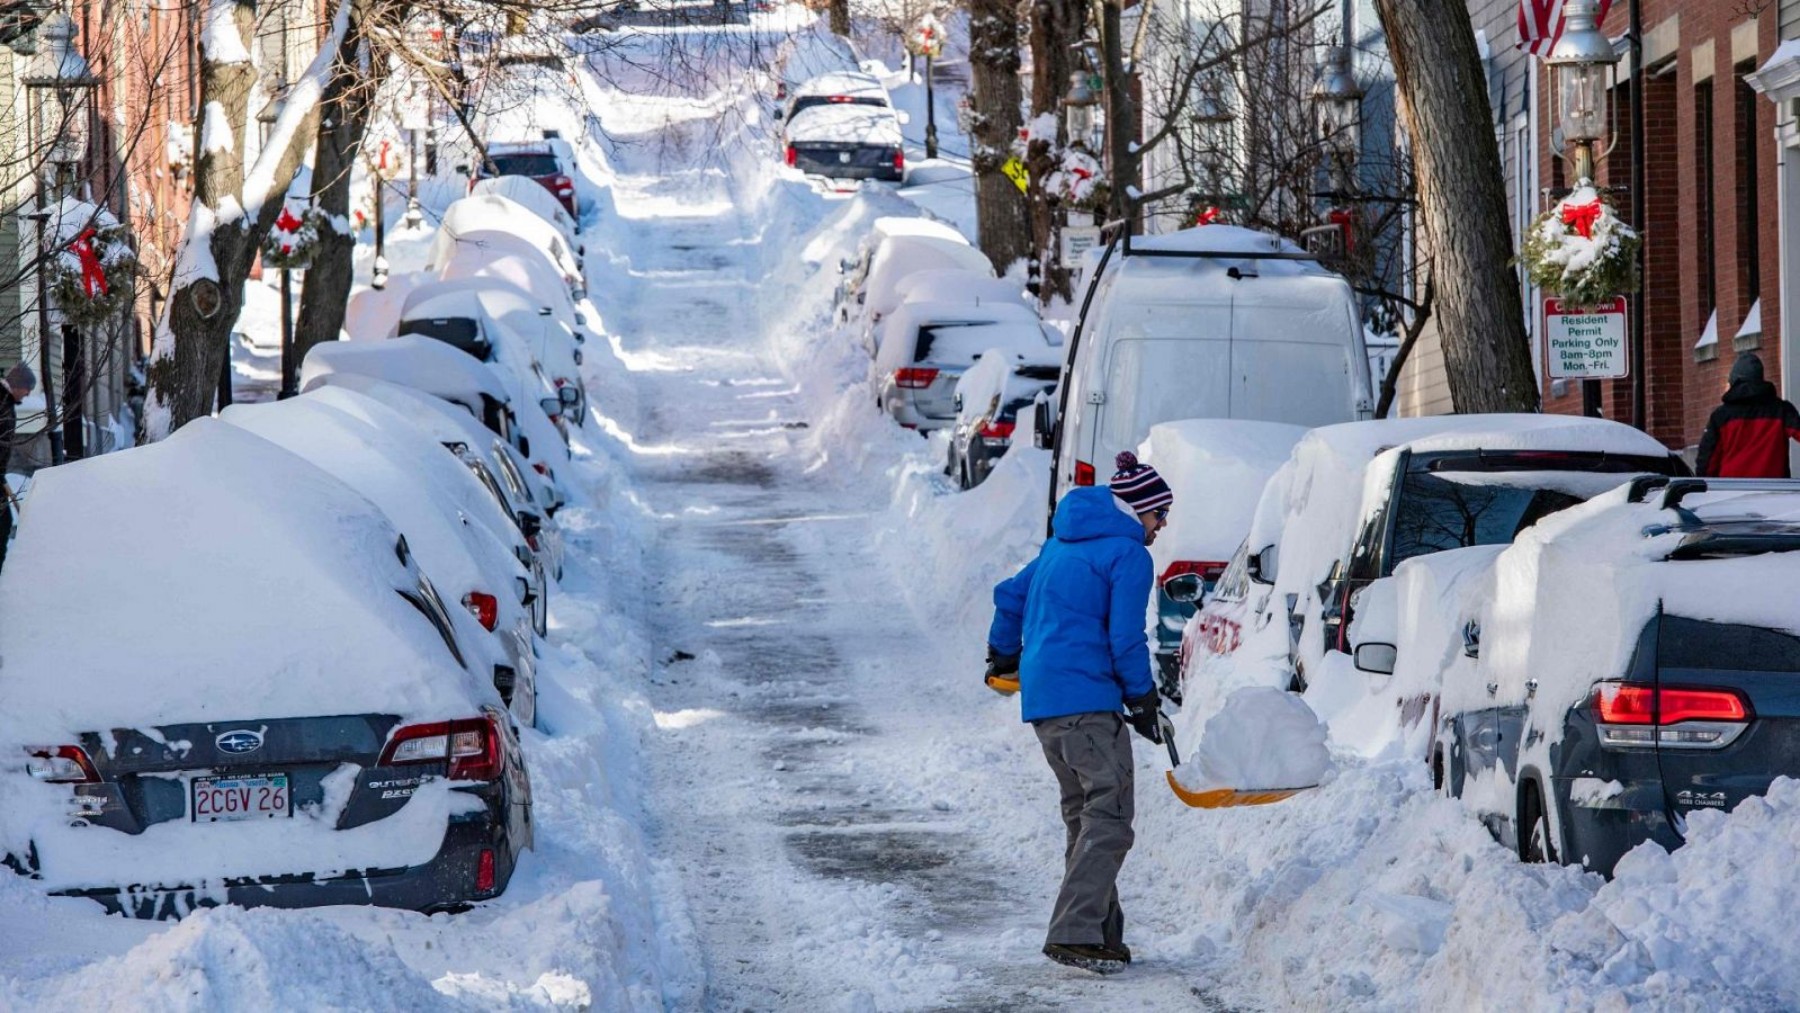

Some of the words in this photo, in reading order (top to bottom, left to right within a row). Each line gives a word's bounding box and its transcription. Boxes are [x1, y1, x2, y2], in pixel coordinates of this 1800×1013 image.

[1561, 315, 1608, 325] Resident
[1568, 326, 1602, 336] Permit
[1552, 338, 1591, 349] Parking
[1595, 337, 1619, 348] Only
[1560, 349, 1612, 359] 8am-8pm
[1677, 790, 1727, 799] 4x4
[197, 787, 251, 814] 2CGV
[259, 787, 284, 811] 26
